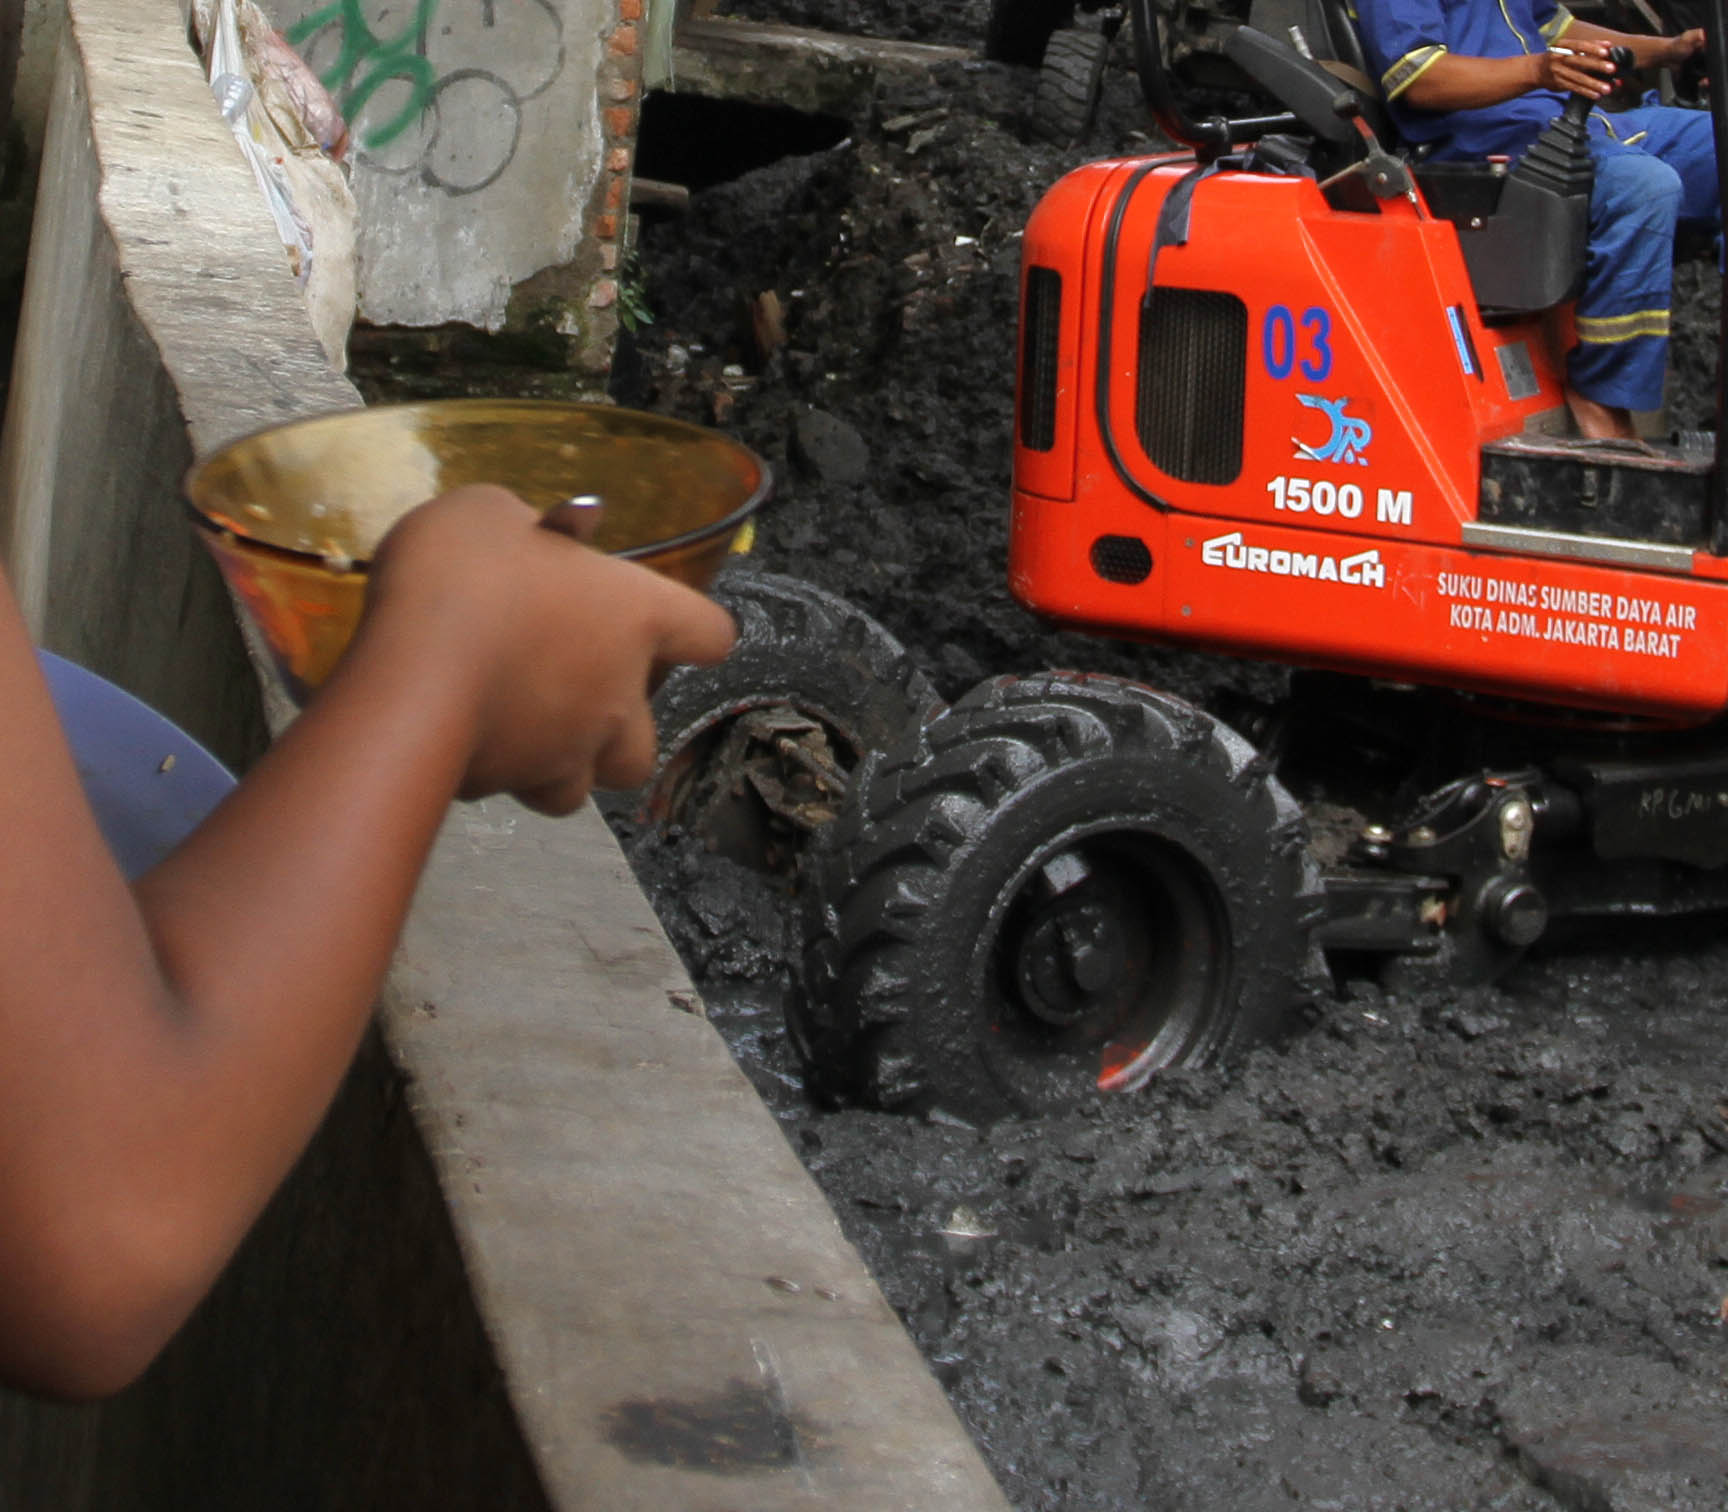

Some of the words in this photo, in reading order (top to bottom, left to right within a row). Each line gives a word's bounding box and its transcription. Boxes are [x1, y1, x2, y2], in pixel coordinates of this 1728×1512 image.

[1263, 304, 1332, 382] 03
[1266, 475, 1364, 519] 1500
[1376, 488, 1413, 526] M
[1201, 532, 1384, 588] EUROMACH
[1437, 572, 1482, 600] SUKU
[1486, 578, 1537, 607] DINAS
[1540, 585, 1612, 618] SUMBER
[1616, 596, 1661, 625] DAYA
[1665, 604, 1697, 630] AIR
[1450, 603, 1493, 632] KOTA
[1495, 611, 1541, 638] ADM.
[1543, 617, 1620, 650] JAKARTA
[1623, 628, 1681, 658] BARAT
